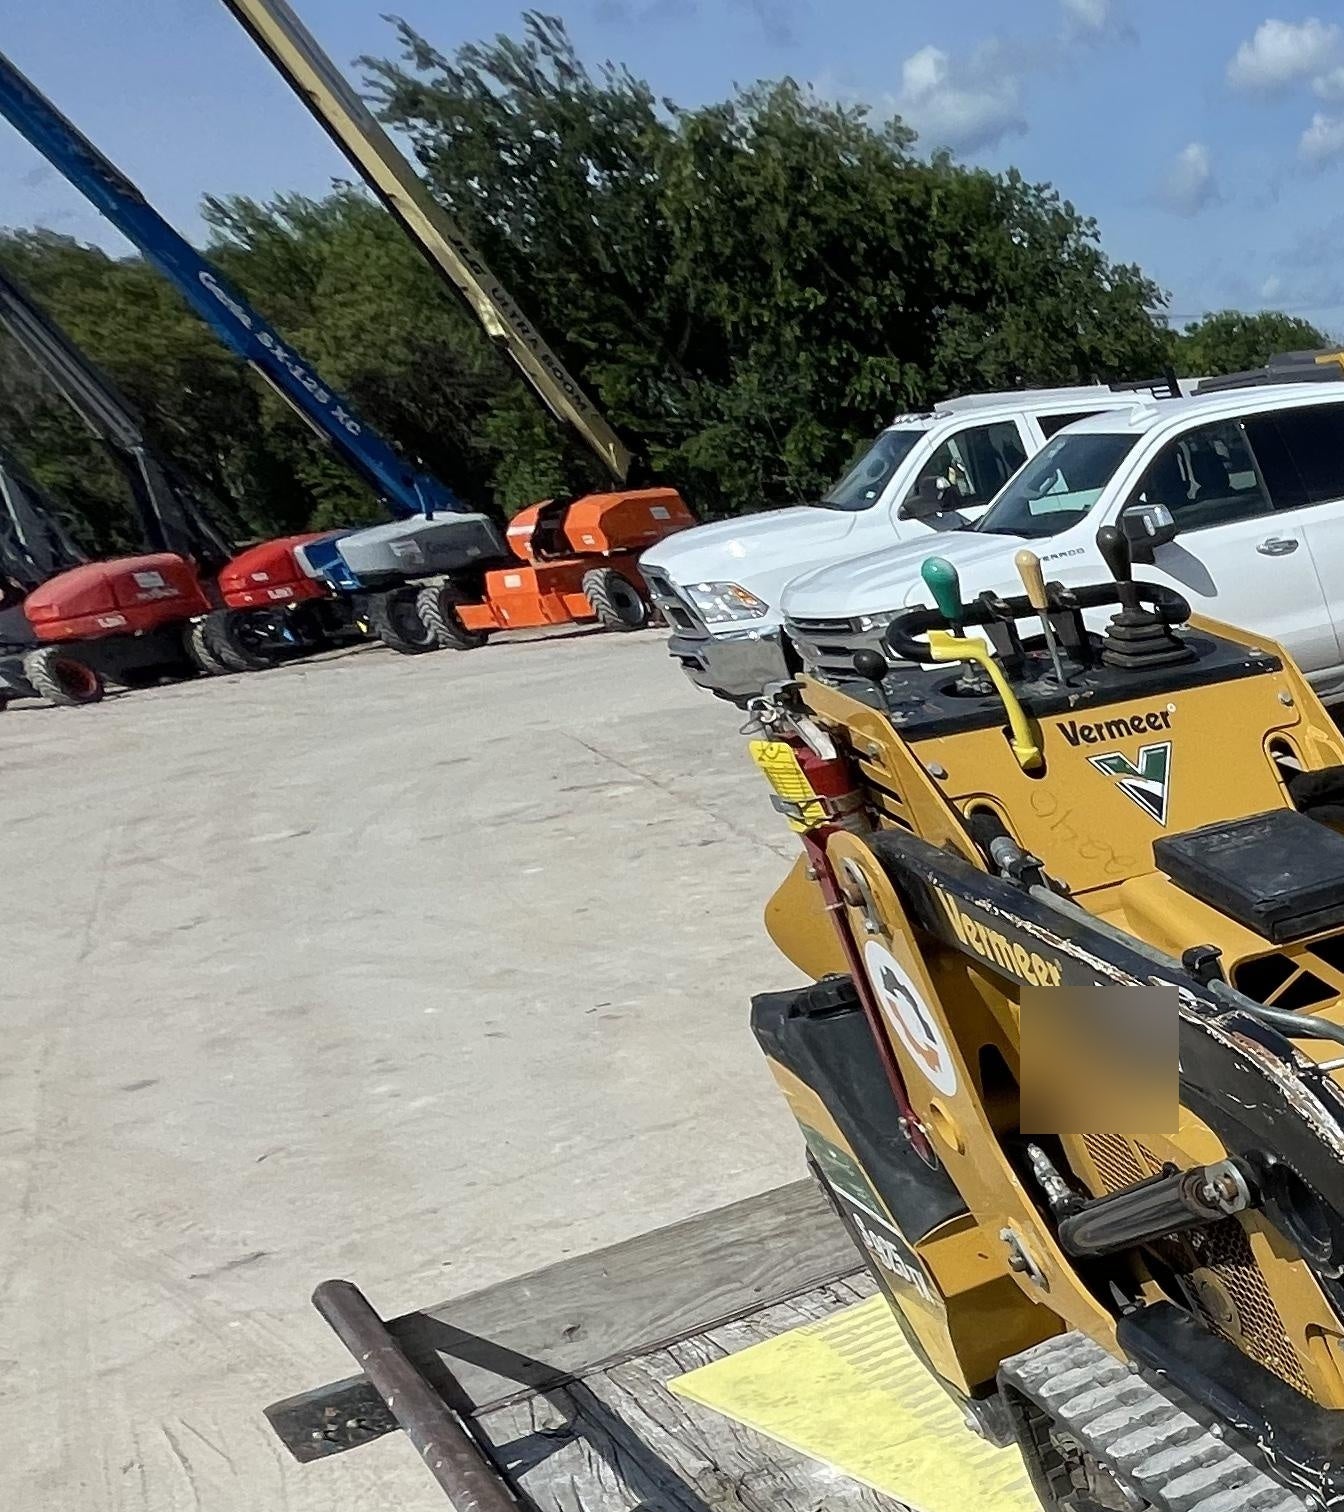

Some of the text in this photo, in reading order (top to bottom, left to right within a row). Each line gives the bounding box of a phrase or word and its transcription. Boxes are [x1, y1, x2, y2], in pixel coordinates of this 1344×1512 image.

[331, 405, 361, 436] XC
[1041, 547, 1086, 561] ERADO
[1056, 709, 1172, 747] Vermeer
[934, 886, 1062, 986] Vermeer
